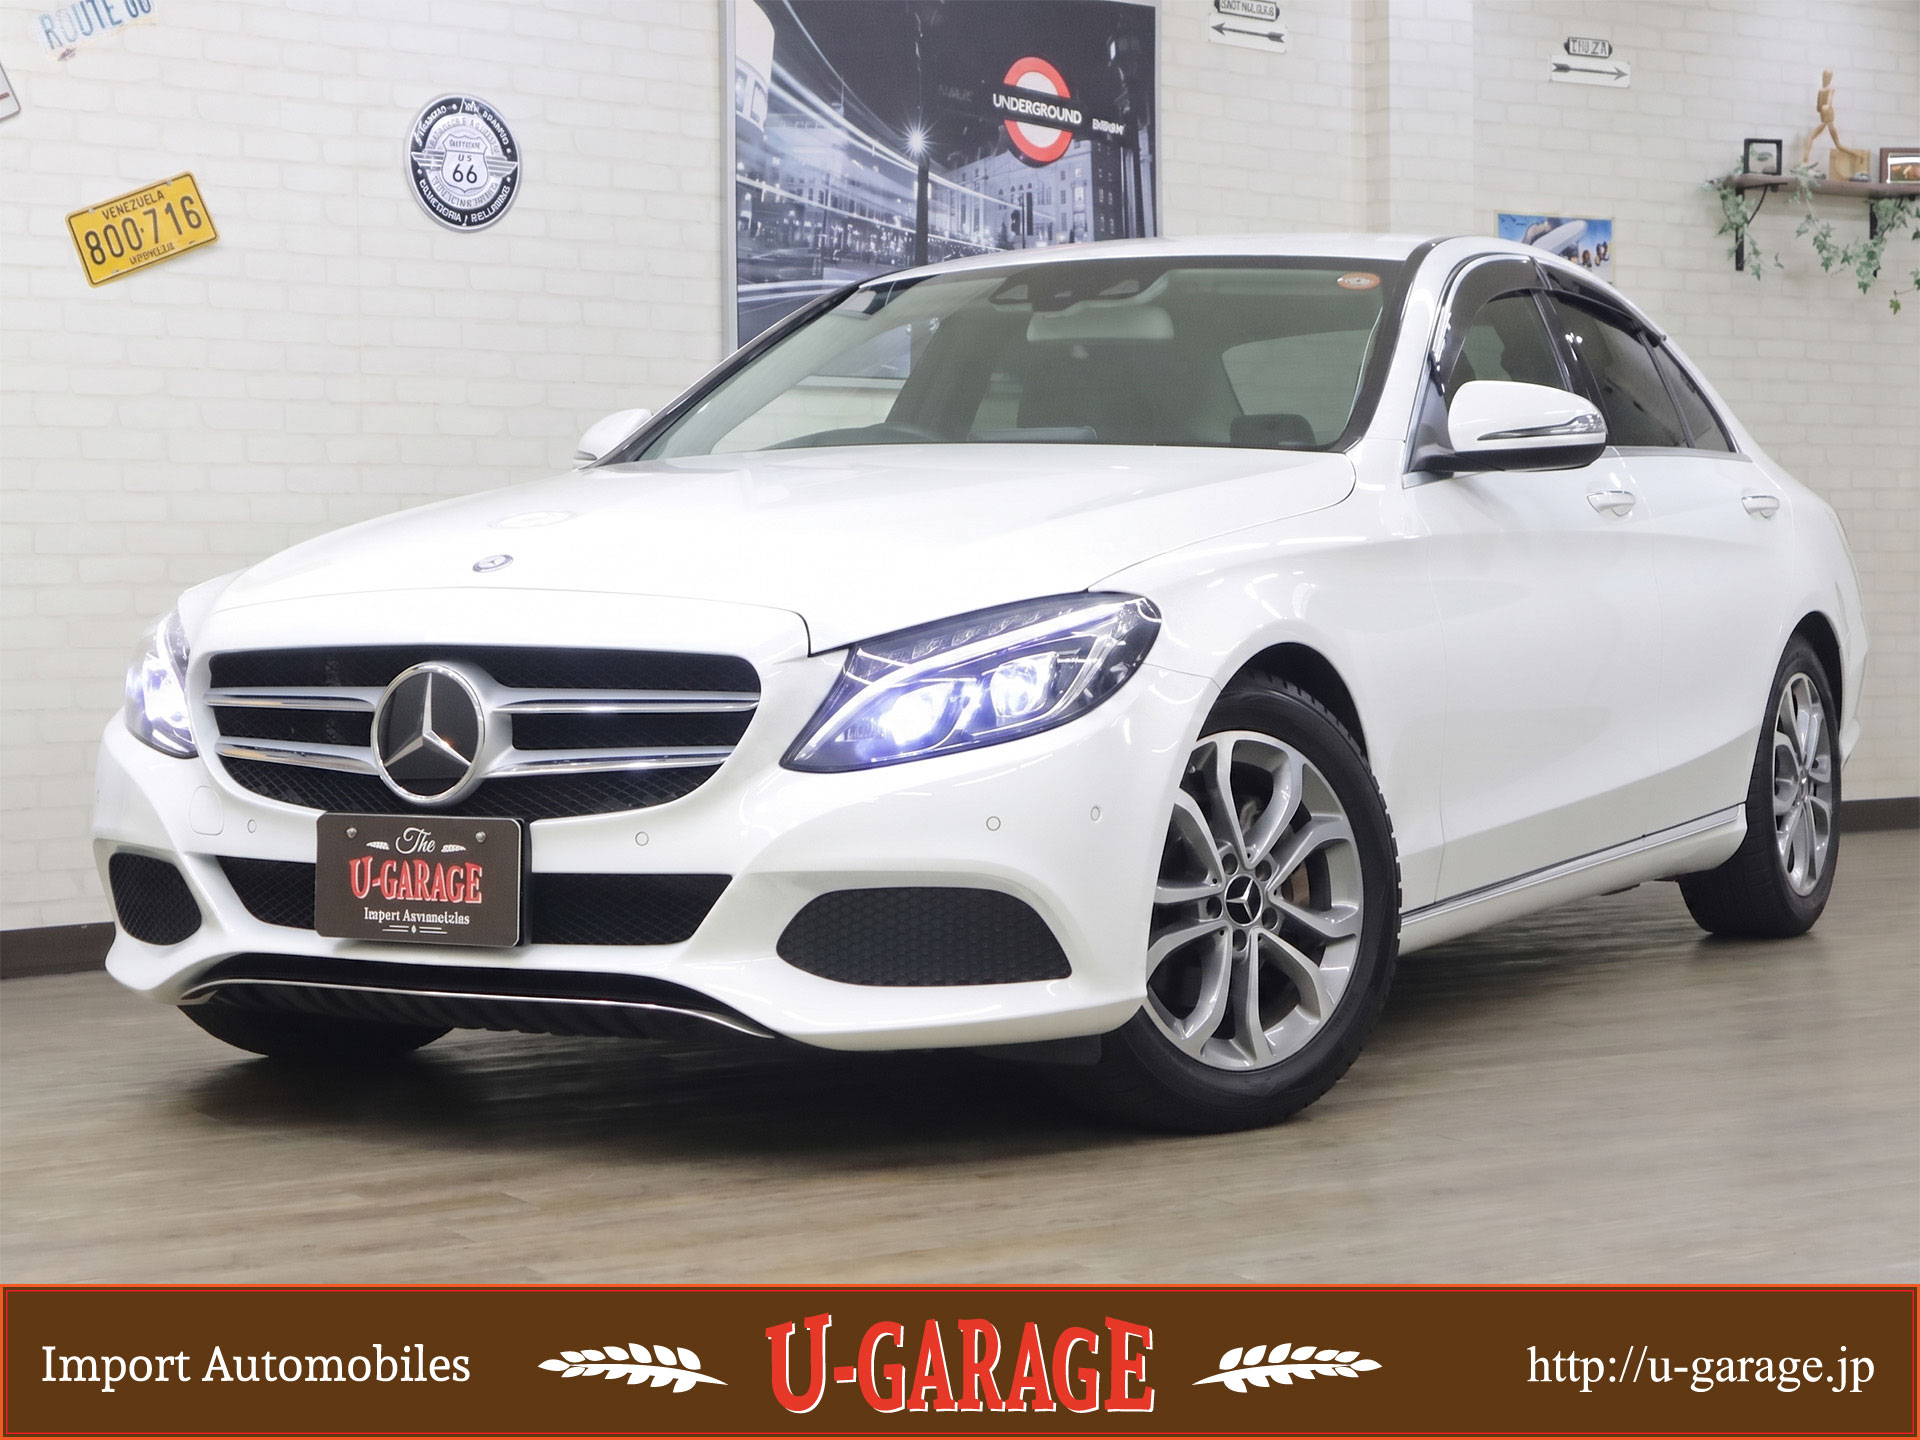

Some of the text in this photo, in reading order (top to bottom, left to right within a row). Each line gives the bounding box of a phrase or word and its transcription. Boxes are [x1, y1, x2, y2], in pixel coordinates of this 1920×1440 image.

[39, 0, 123, 50] ROUTE
[992, 93, 1083, 125] UNDERGROUND
[452, 163, 477, 184] 66
[101, 190, 165, 220] VENEZUELA
[395, 827, 436, 854] The
[349, 855, 483, 904] U-GARAGE
